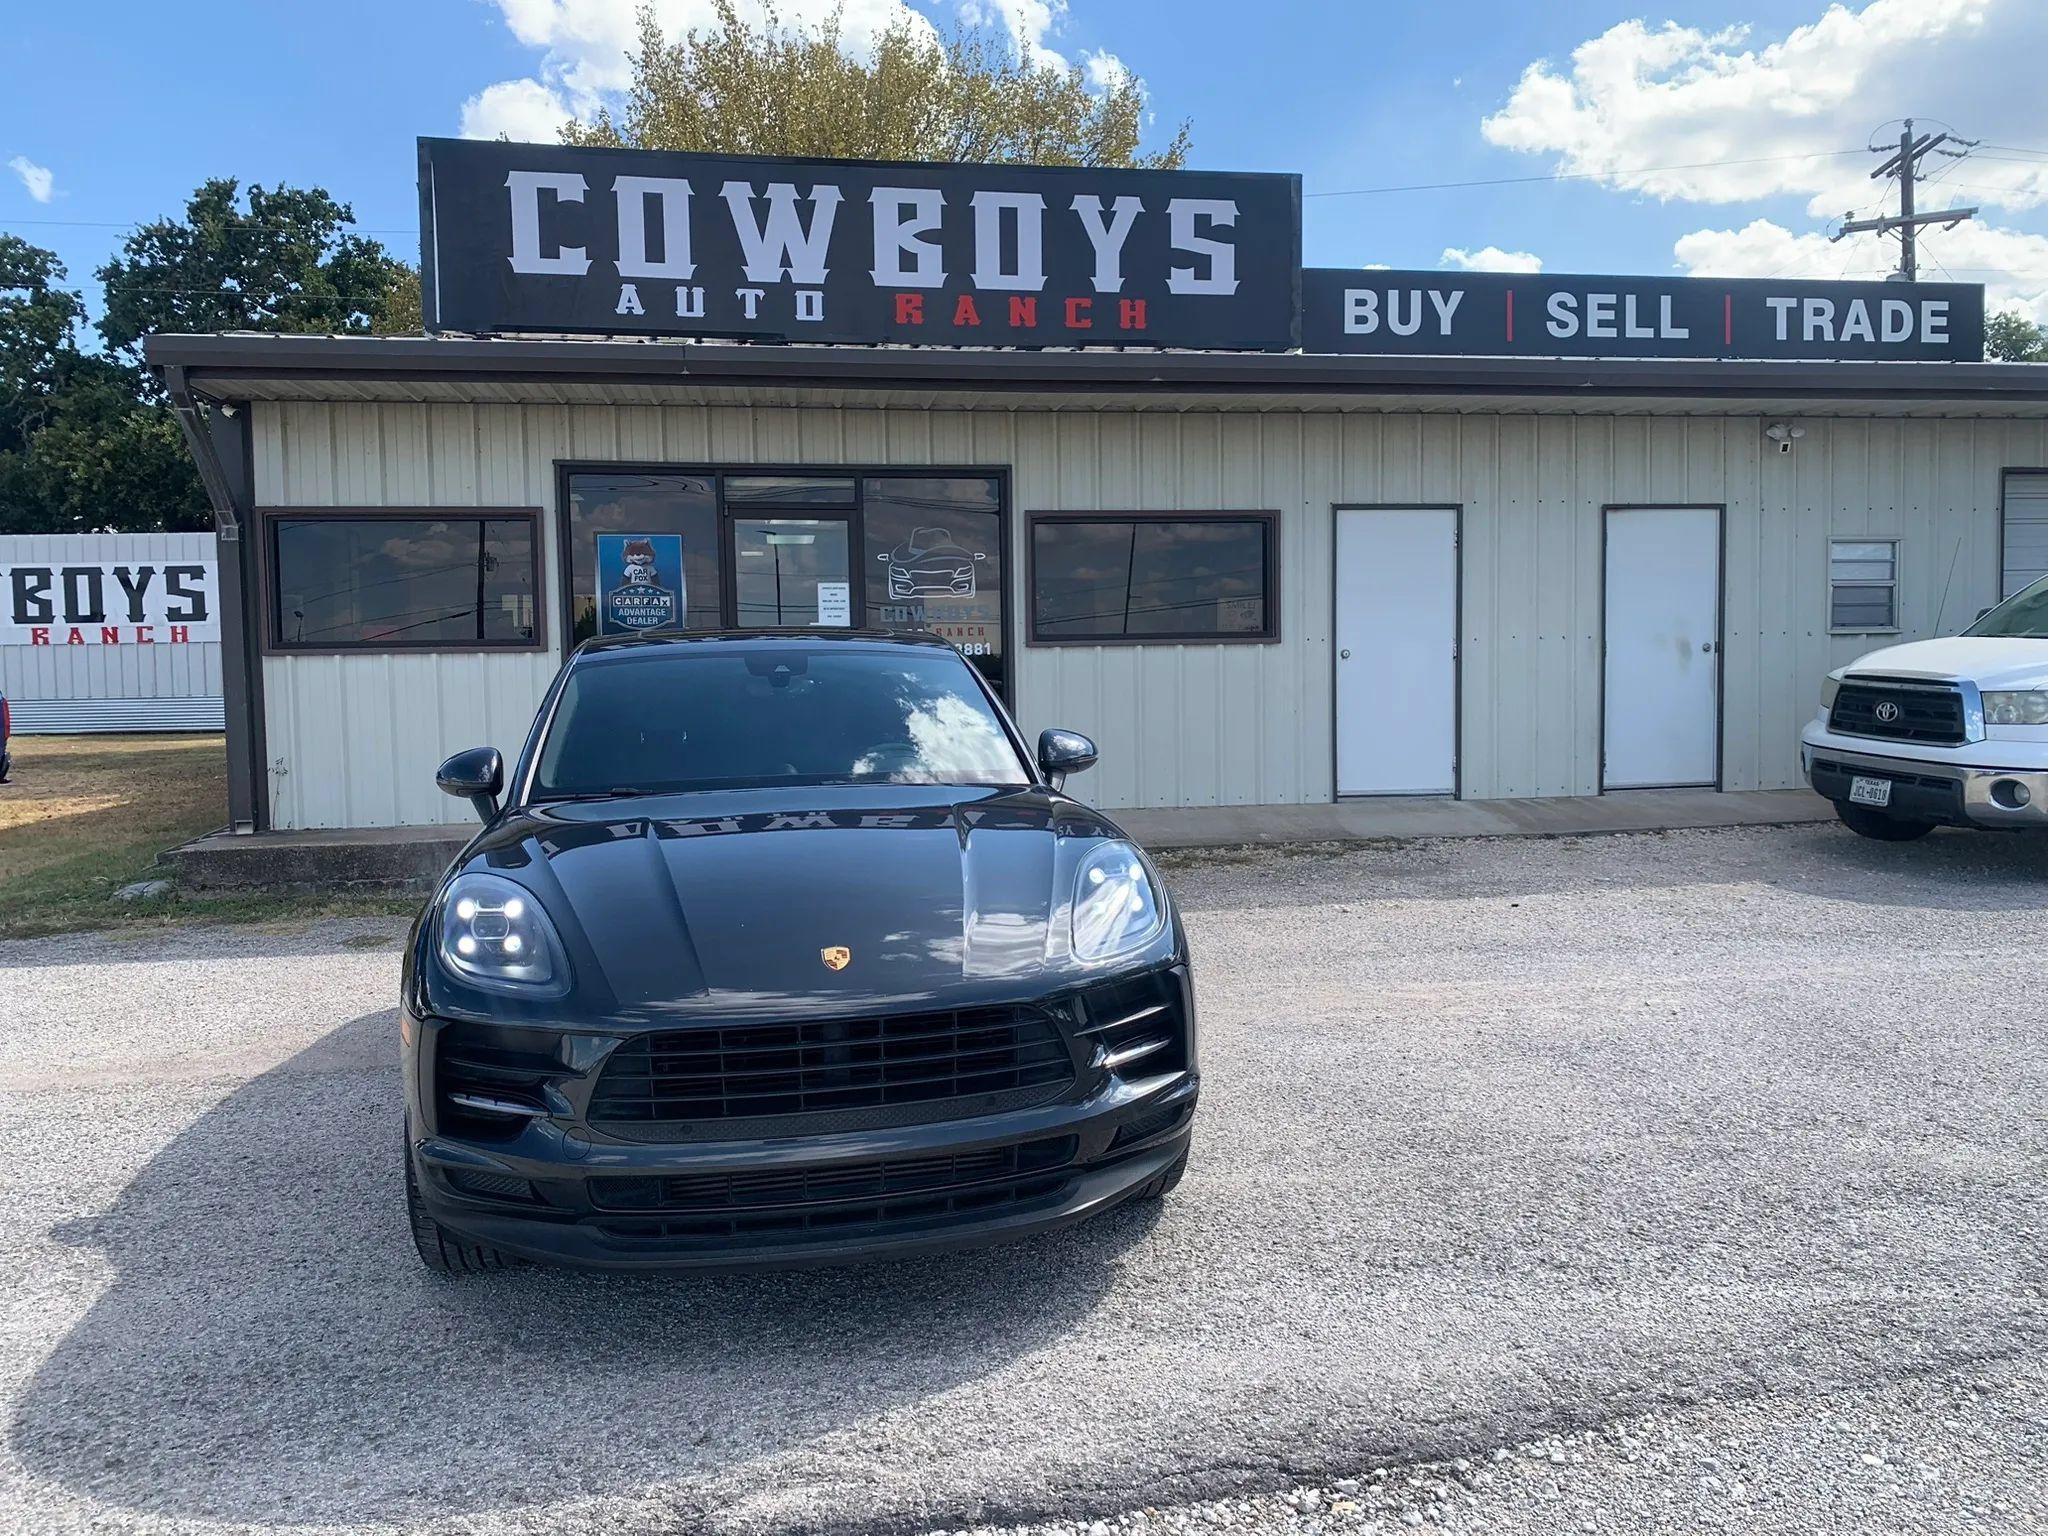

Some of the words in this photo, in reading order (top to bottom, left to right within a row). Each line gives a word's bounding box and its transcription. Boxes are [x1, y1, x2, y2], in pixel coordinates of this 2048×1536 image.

[504, 170, 1241, 295] COWBOYS
[616, 283, 825, 322] AUTO
[895, 292, 1148, 330] RANCH
[1343, 288, 1464, 336] BUY
[1546, 291, 1690, 340] SELL
[1766, 297, 1950, 344] TRADE
[0, 565, 210, 624] BOYS
[614, 596, 670, 606] CARFAX
[618, 608, 667, 616] ADVANTAGE
[626, 616, 659, 625] DEALER
[31, 625, 188, 645] RANCH
[935, 627, 985, 637] RANCH
